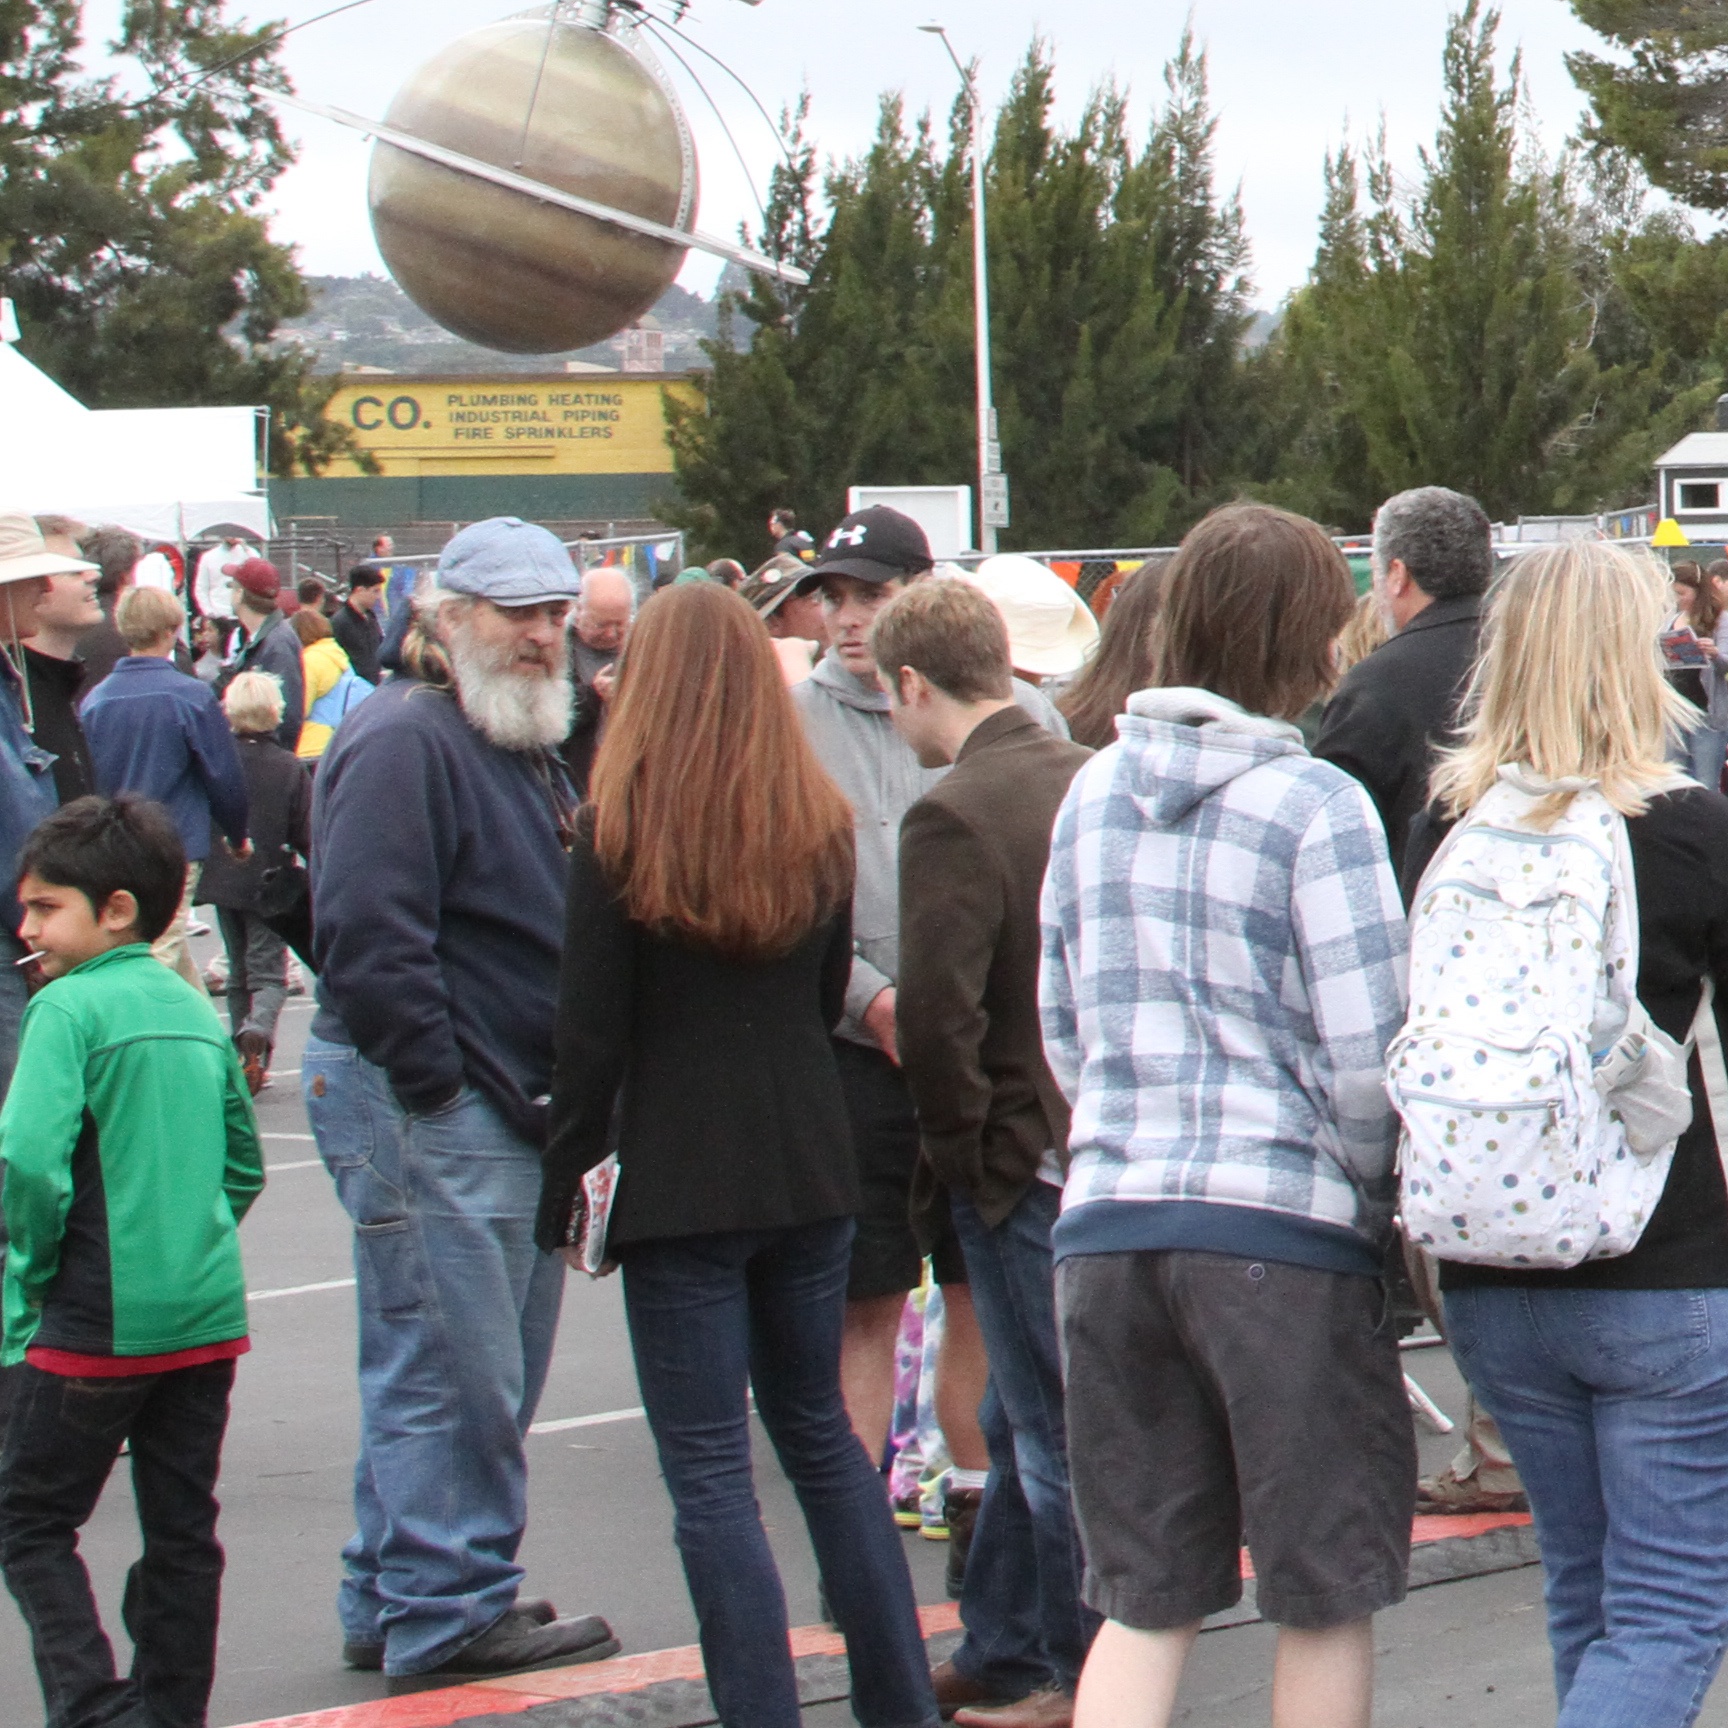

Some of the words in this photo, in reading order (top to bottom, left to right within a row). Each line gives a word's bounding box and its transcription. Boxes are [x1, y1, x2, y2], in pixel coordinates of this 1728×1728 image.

[447, 393, 538, 407] PLUMBING
[548, 393, 623, 407] HEATING
[351, 395, 433, 431] CO.
[449, 409, 550, 423] INDUSTRIAL
[563, 409, 620, 422] PIPING
[454, 426, 493, 439] FIRE
[505, 426, 613, 440] SPRINKLERS
